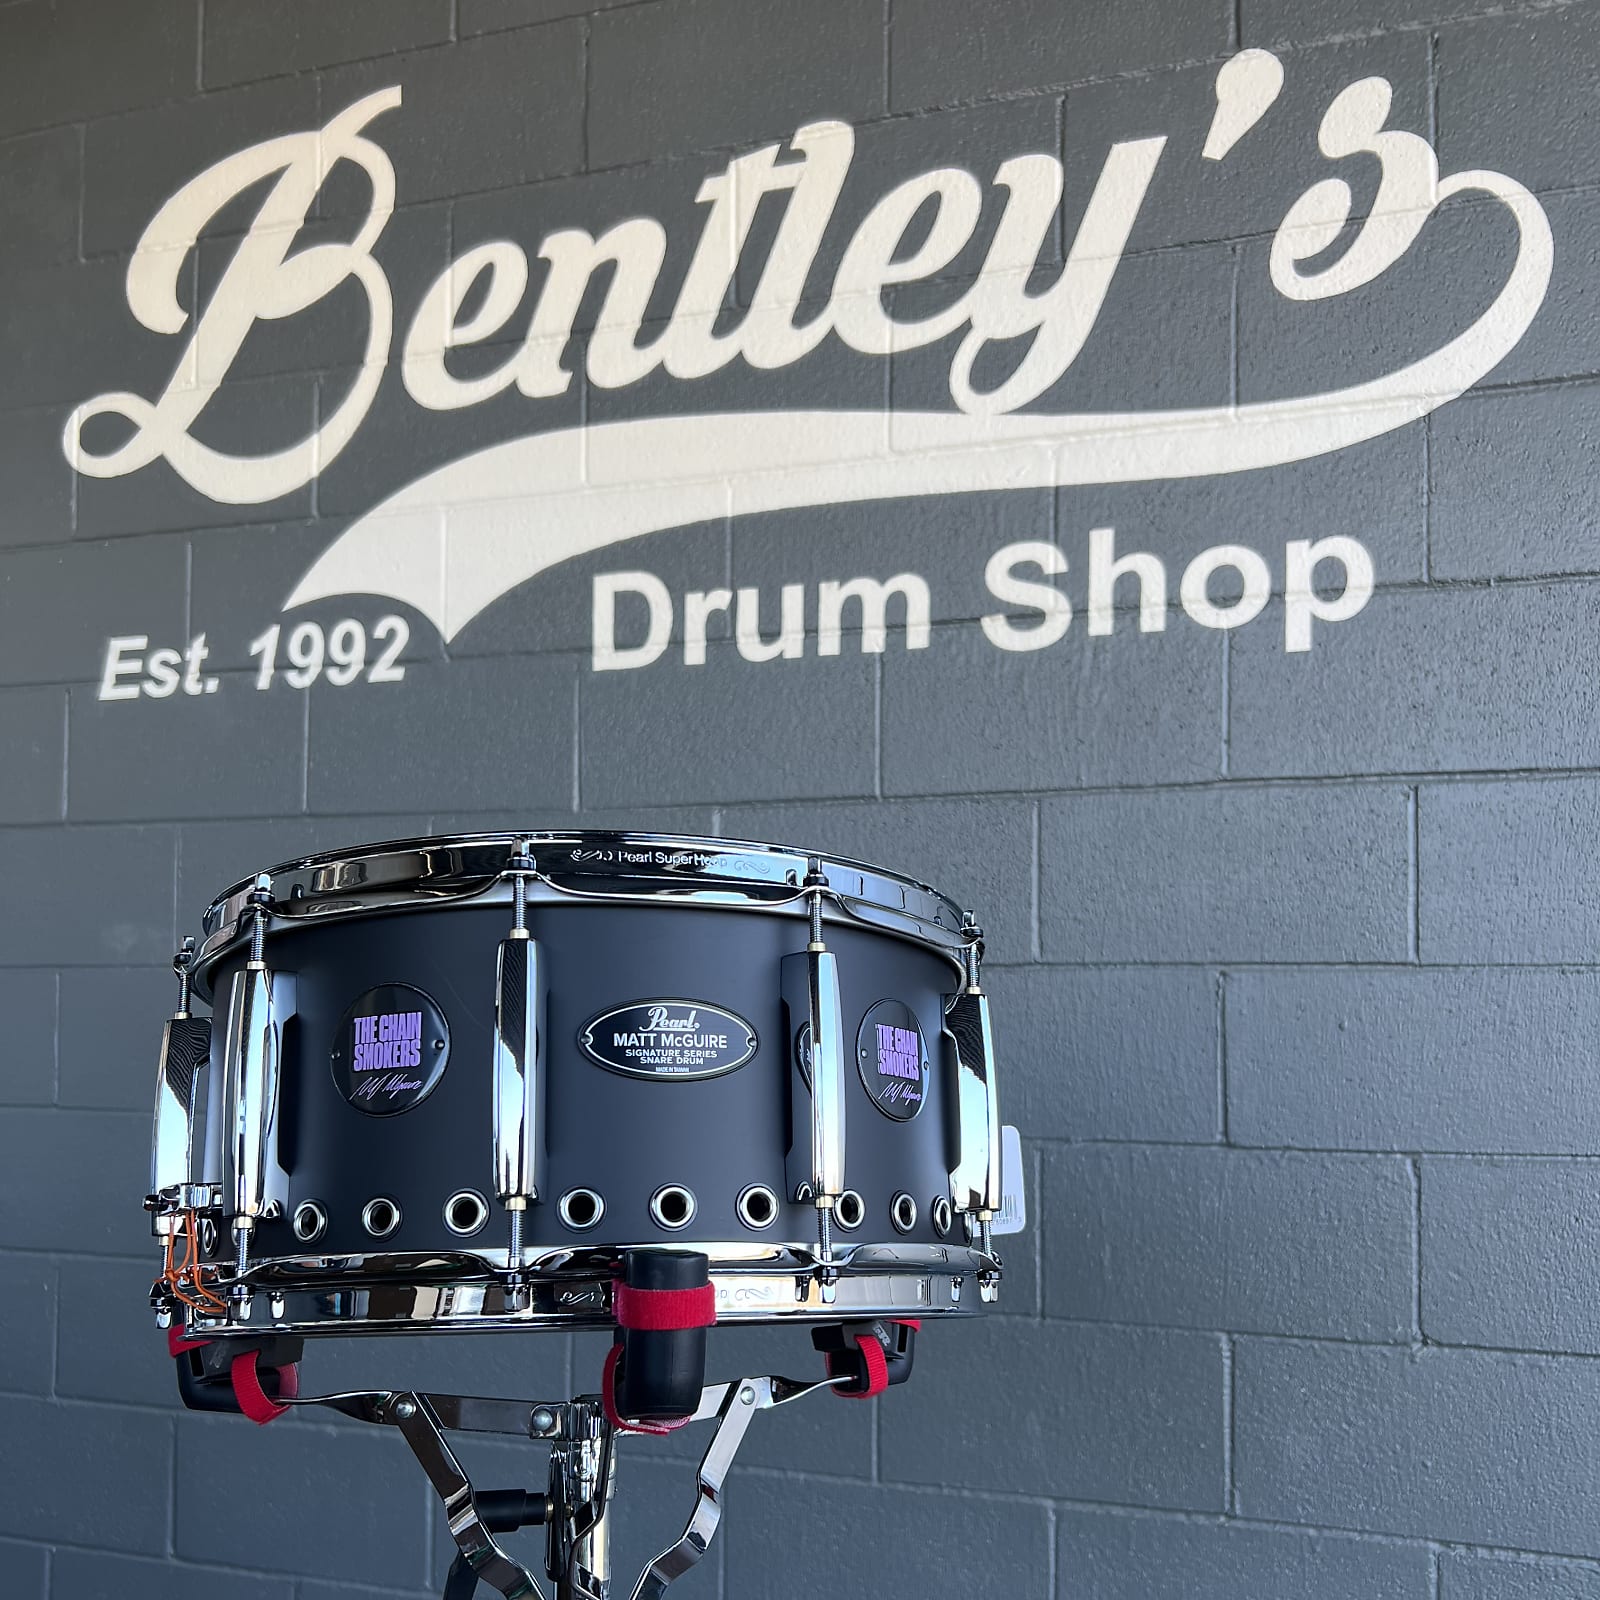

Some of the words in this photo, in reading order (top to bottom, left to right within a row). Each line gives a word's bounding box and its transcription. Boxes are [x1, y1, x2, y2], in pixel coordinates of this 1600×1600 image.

[62, 48, 1554, 504] Bentley's
[592, 571, 931, 672] Drum
[980, 527, 1377, 653] Shop
[99, 632, 219, 700] Est.
[250, 615, 409, 690] 1992
[618, 851, 652, 863] Pearl
[354, 1016, 378, 1044] THE
[379, 1011, 421, 1041] CHAIN
[613, 1033, 657, 1047] MATT
[661, 1034, 727, 1048] McGUIRE
[875, 1024, 894, 1051] THE
[354, 1040, 421, 1071] SMOKERS
[625, 1049, 680, 1057] SIGNATURE
[683, 1050, 717, 1058] SERIES
[878, 1049, 919, 1080] SMOKERS
